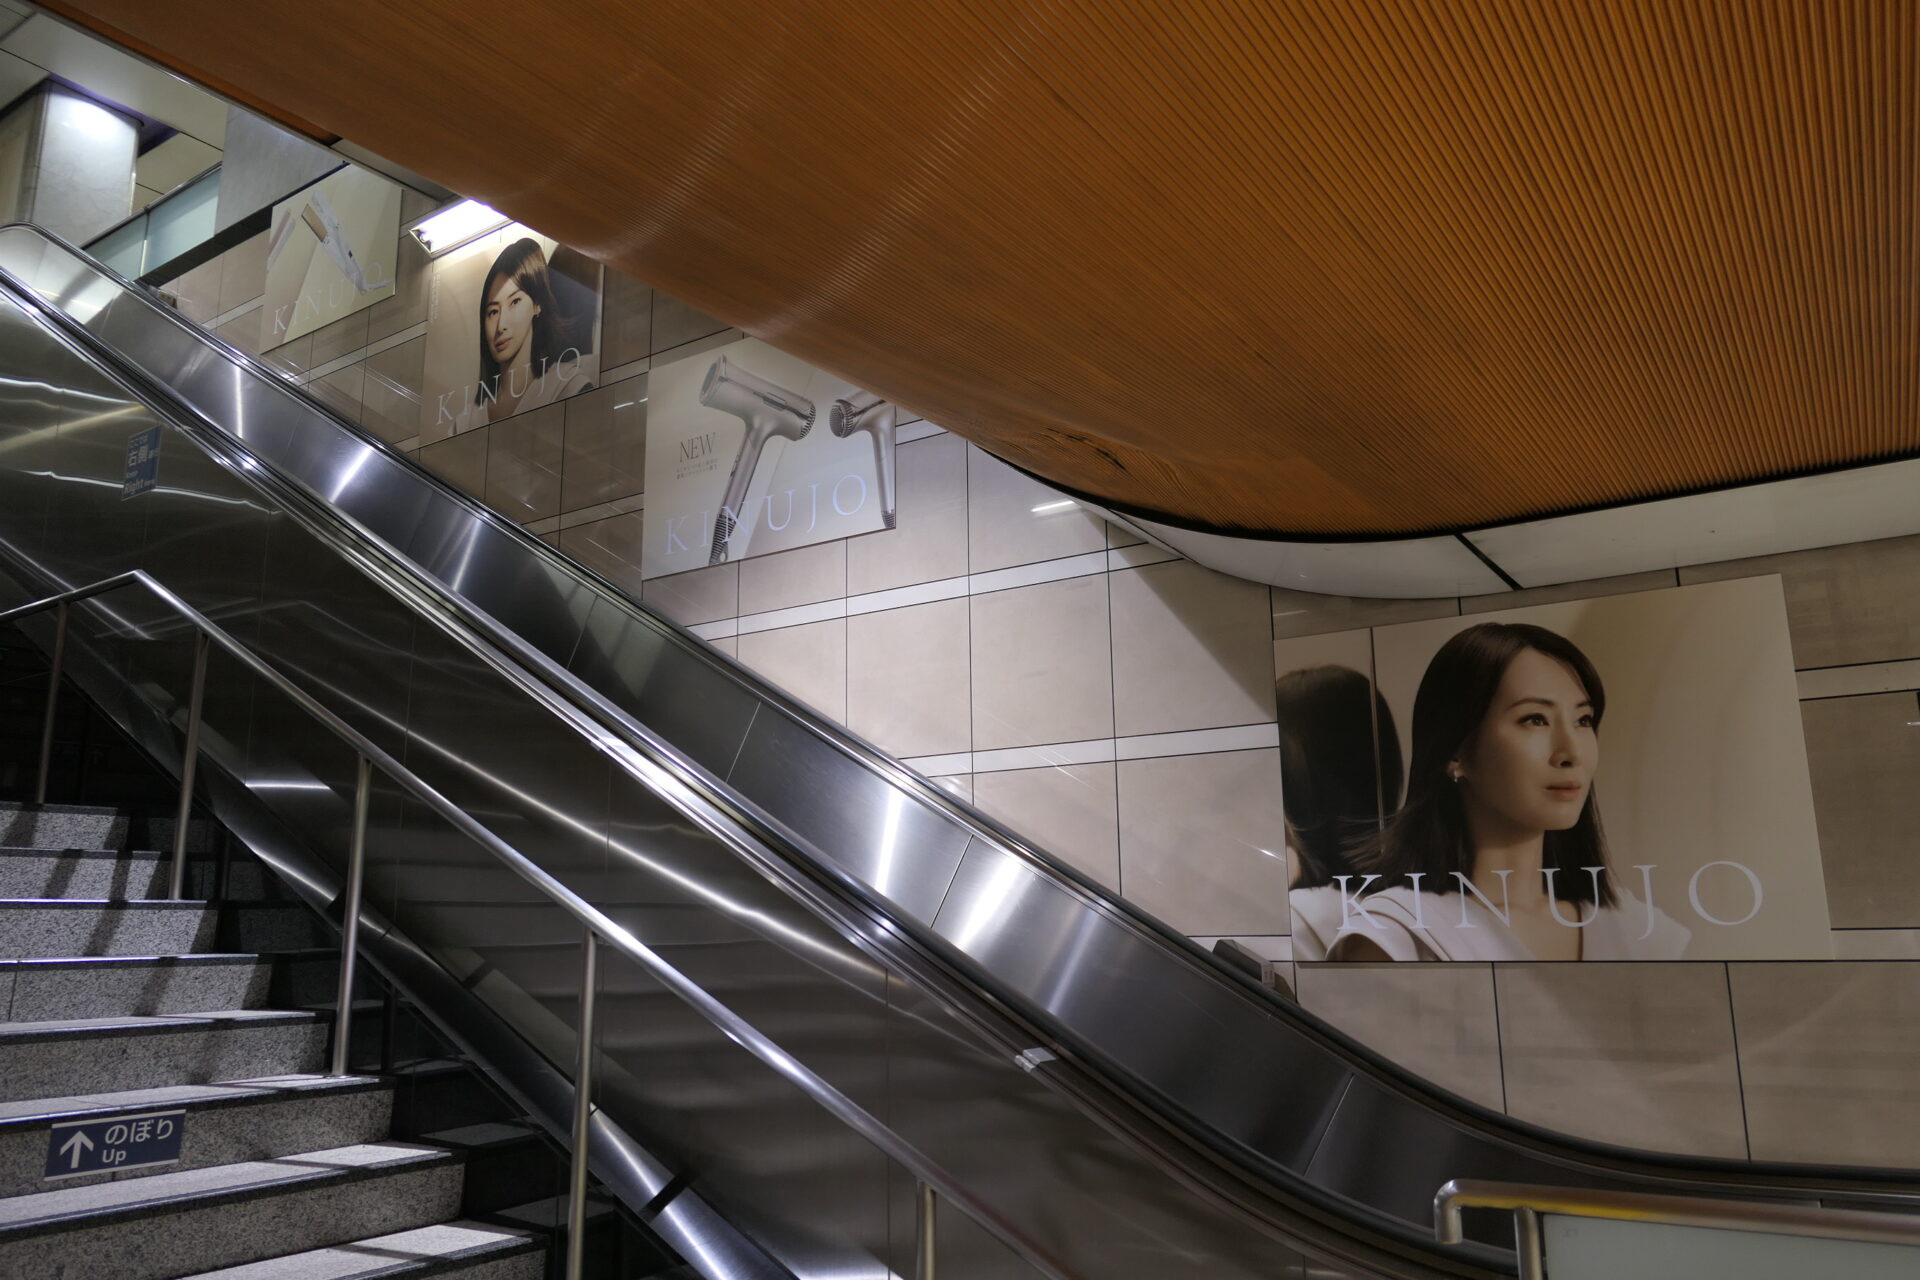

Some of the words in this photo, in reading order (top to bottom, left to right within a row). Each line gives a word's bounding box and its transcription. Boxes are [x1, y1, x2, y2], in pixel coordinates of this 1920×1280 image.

[272, 261, 382, 334] KINUJO
[436, 347, 581, 425] KINUJO
[679, 431, 717, 463] NEW
[664, 474, 868, 556] KINUJO
[1332, 860, 1764, 940] KINUJO
[101, 1148, 127, 1165] Up
[104, 1118, 174, 1145] のぼり
